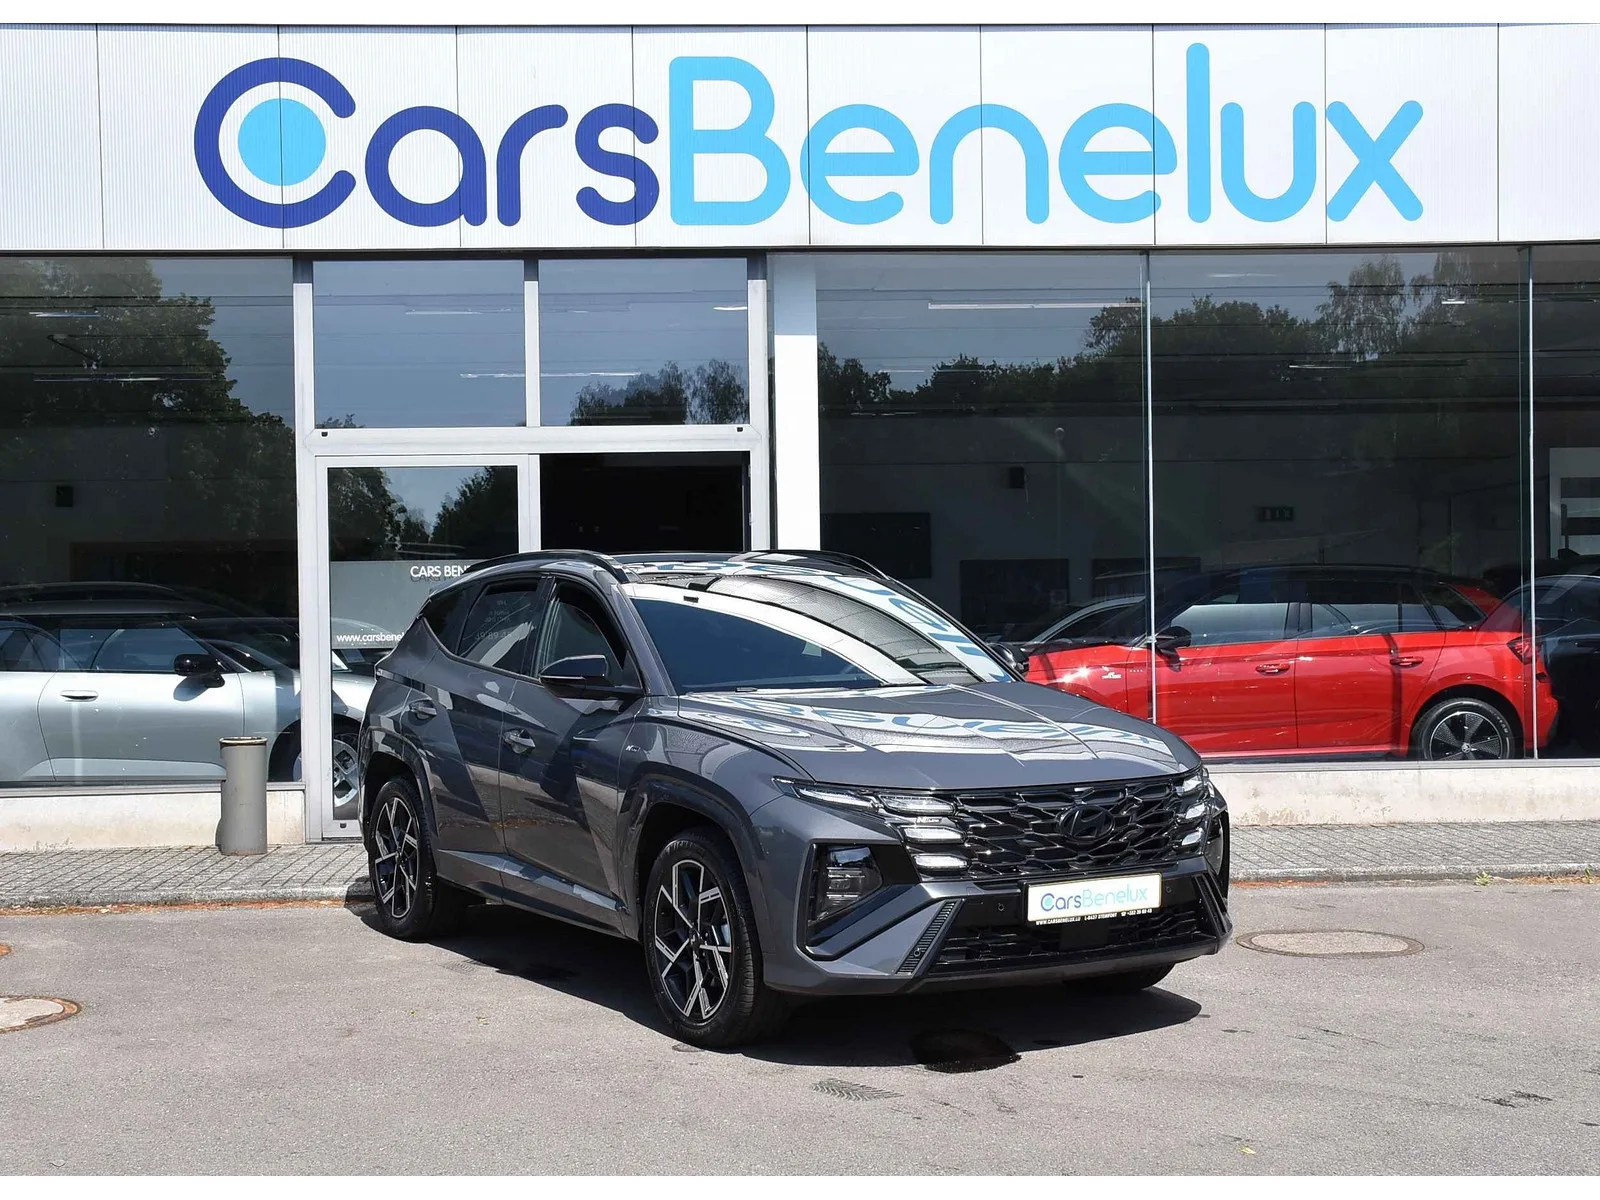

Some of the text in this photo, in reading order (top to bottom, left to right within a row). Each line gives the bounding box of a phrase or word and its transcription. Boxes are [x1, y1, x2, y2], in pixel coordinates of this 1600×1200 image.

[194, 42, 1423, 228] CarsBenelux
[410, 564, 470, 578] CARS BEN
[1040, 884, 1148, 912] CarsBenelux
